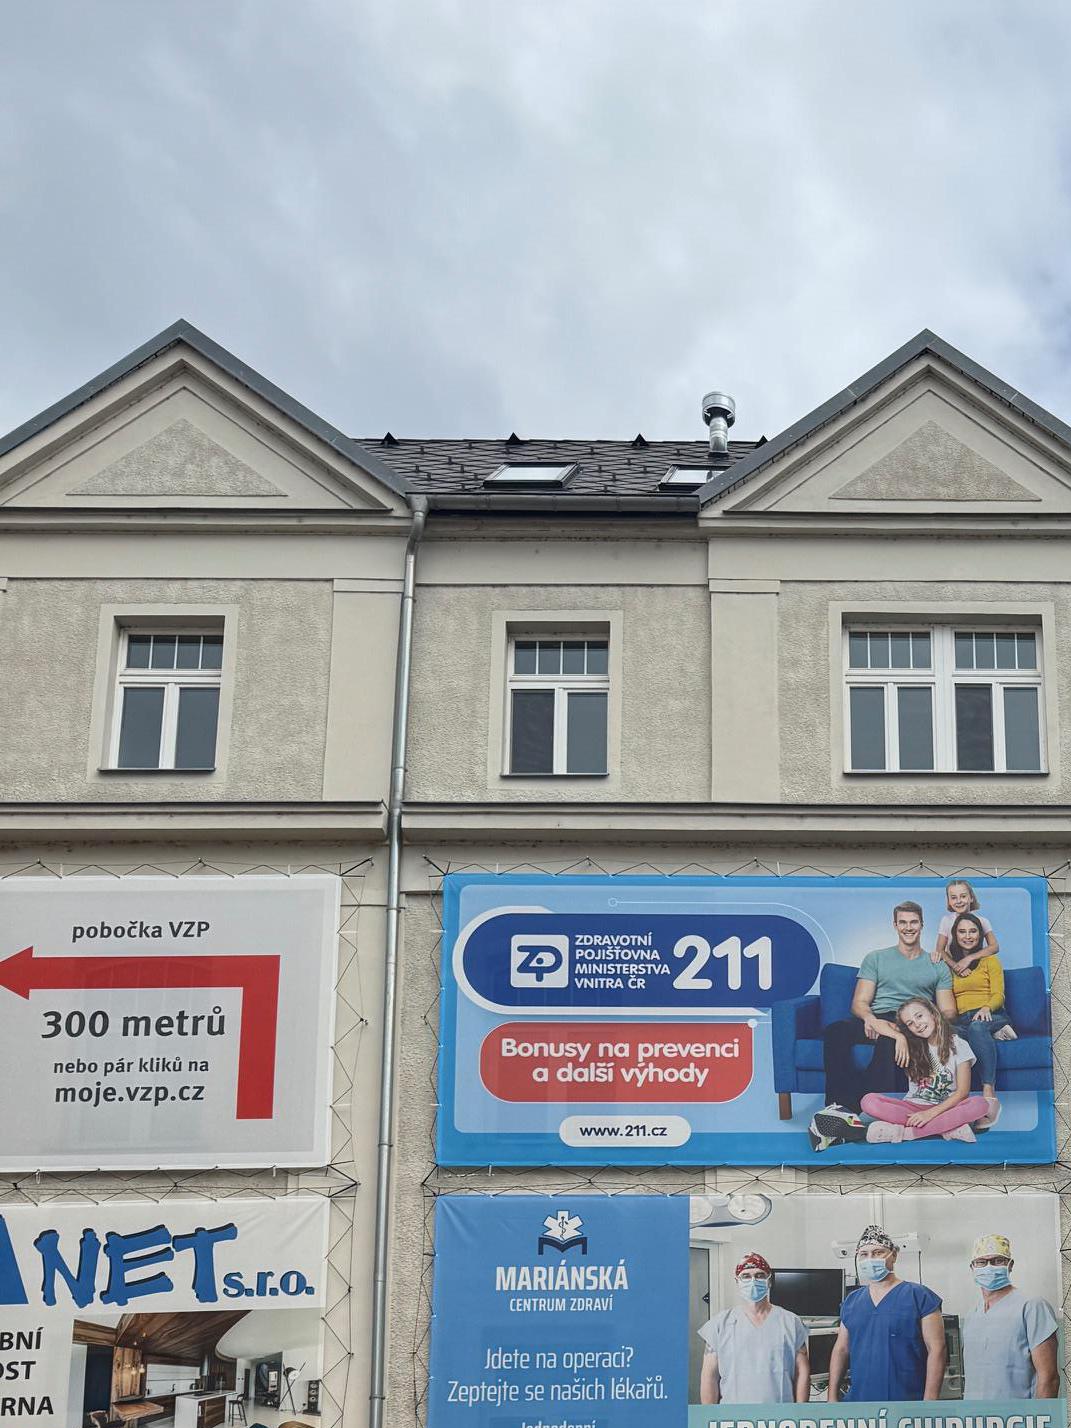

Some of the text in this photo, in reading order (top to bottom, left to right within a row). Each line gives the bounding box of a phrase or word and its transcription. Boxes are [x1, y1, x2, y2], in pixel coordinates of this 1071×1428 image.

[72, 921, 210, 943] pobočka VZP
[575, 932, 652, 946] ZDRAVOTNÍ
[575, 946, 660, 960] POJIŠŤOVNA
[672, 934, 772, 991] 211
[575, 963, 670, 975] MINISTERSTVA
[575, 974, 646, 989] VNITRA ČR
[41, 1006, 226, 1039] 300 metrů
[501, 1038, 740, 1063] Bonusy na prevenci
[53, 1057, 209, 1077] nebo pár kliků na
[532, 1062, 709, 1088] a další výhody
[55, 1081, 205, 1107] moje.vzp.cz
[579, 1124, 667, 1138] www.211.cz
[223, 1270, 314, 1298] s.r.o.
[495, 1259, 629, 1291] MARIÁNSKÁ
[510, 1294, 613, 1312] CENTRUM ZDRAVÍ
[484, 1346, 634, 1372] Jdete na operaci?
[448, 1375, 668, 1407] Zeptejte se našich lékařů.
[1, 1396, 54, 1416] RNA
